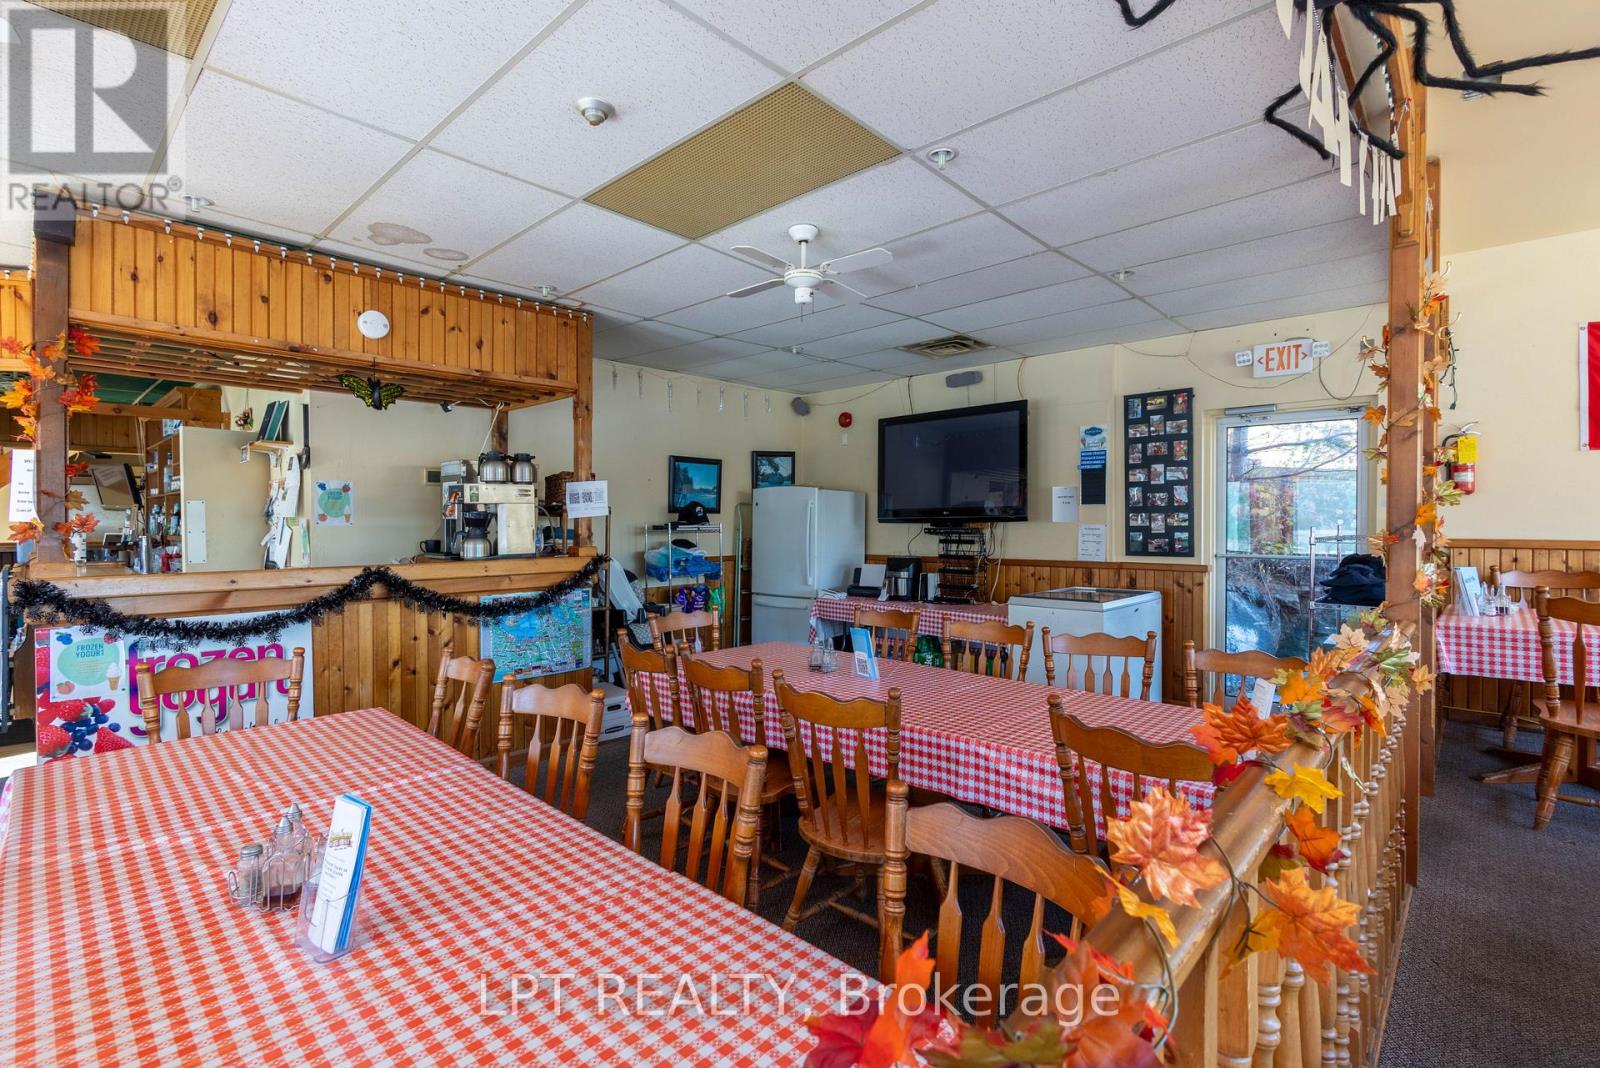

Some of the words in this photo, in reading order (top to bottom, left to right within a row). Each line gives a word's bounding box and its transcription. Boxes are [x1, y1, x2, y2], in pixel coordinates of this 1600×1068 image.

[1265, 344, 1302, 371] EXIT
[76, 643, 104, 651] FROZEN
[76, 650, 104, 658] YOGURT
[126, 641, 284, 687] froen
[129, 678, 291, 737] yogu
